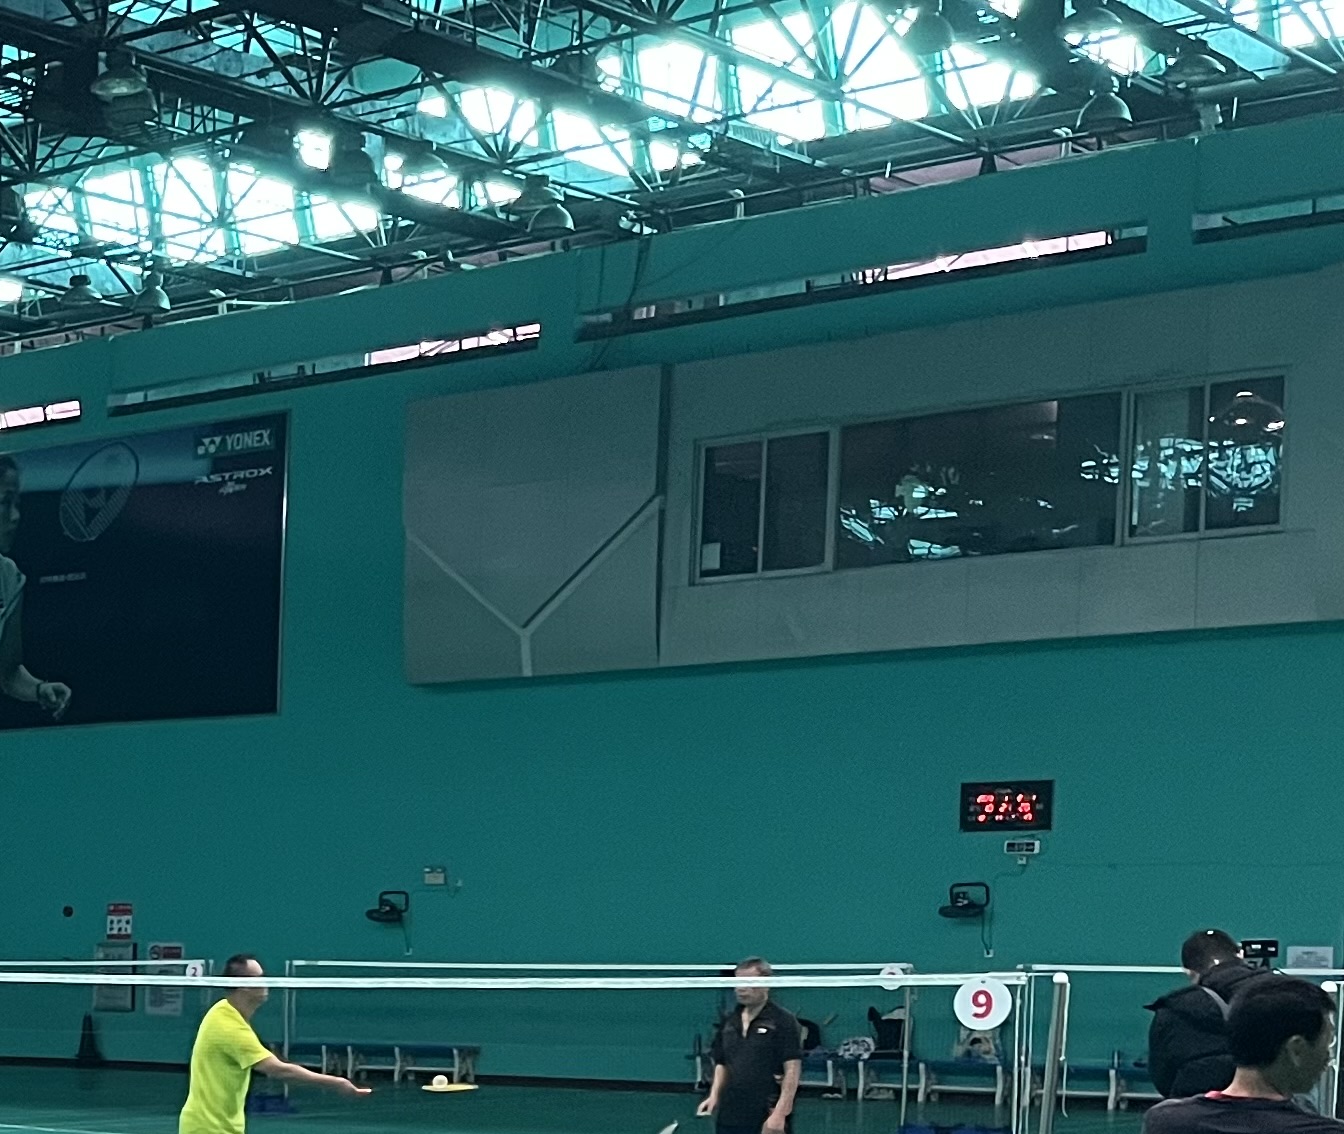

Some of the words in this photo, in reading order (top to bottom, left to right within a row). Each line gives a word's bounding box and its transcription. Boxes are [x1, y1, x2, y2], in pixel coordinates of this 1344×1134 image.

[225, 428, 271, 452] YONEX
[194, 466, 273, 485] ASTROX
[971, 989, 994, 1019] 9
